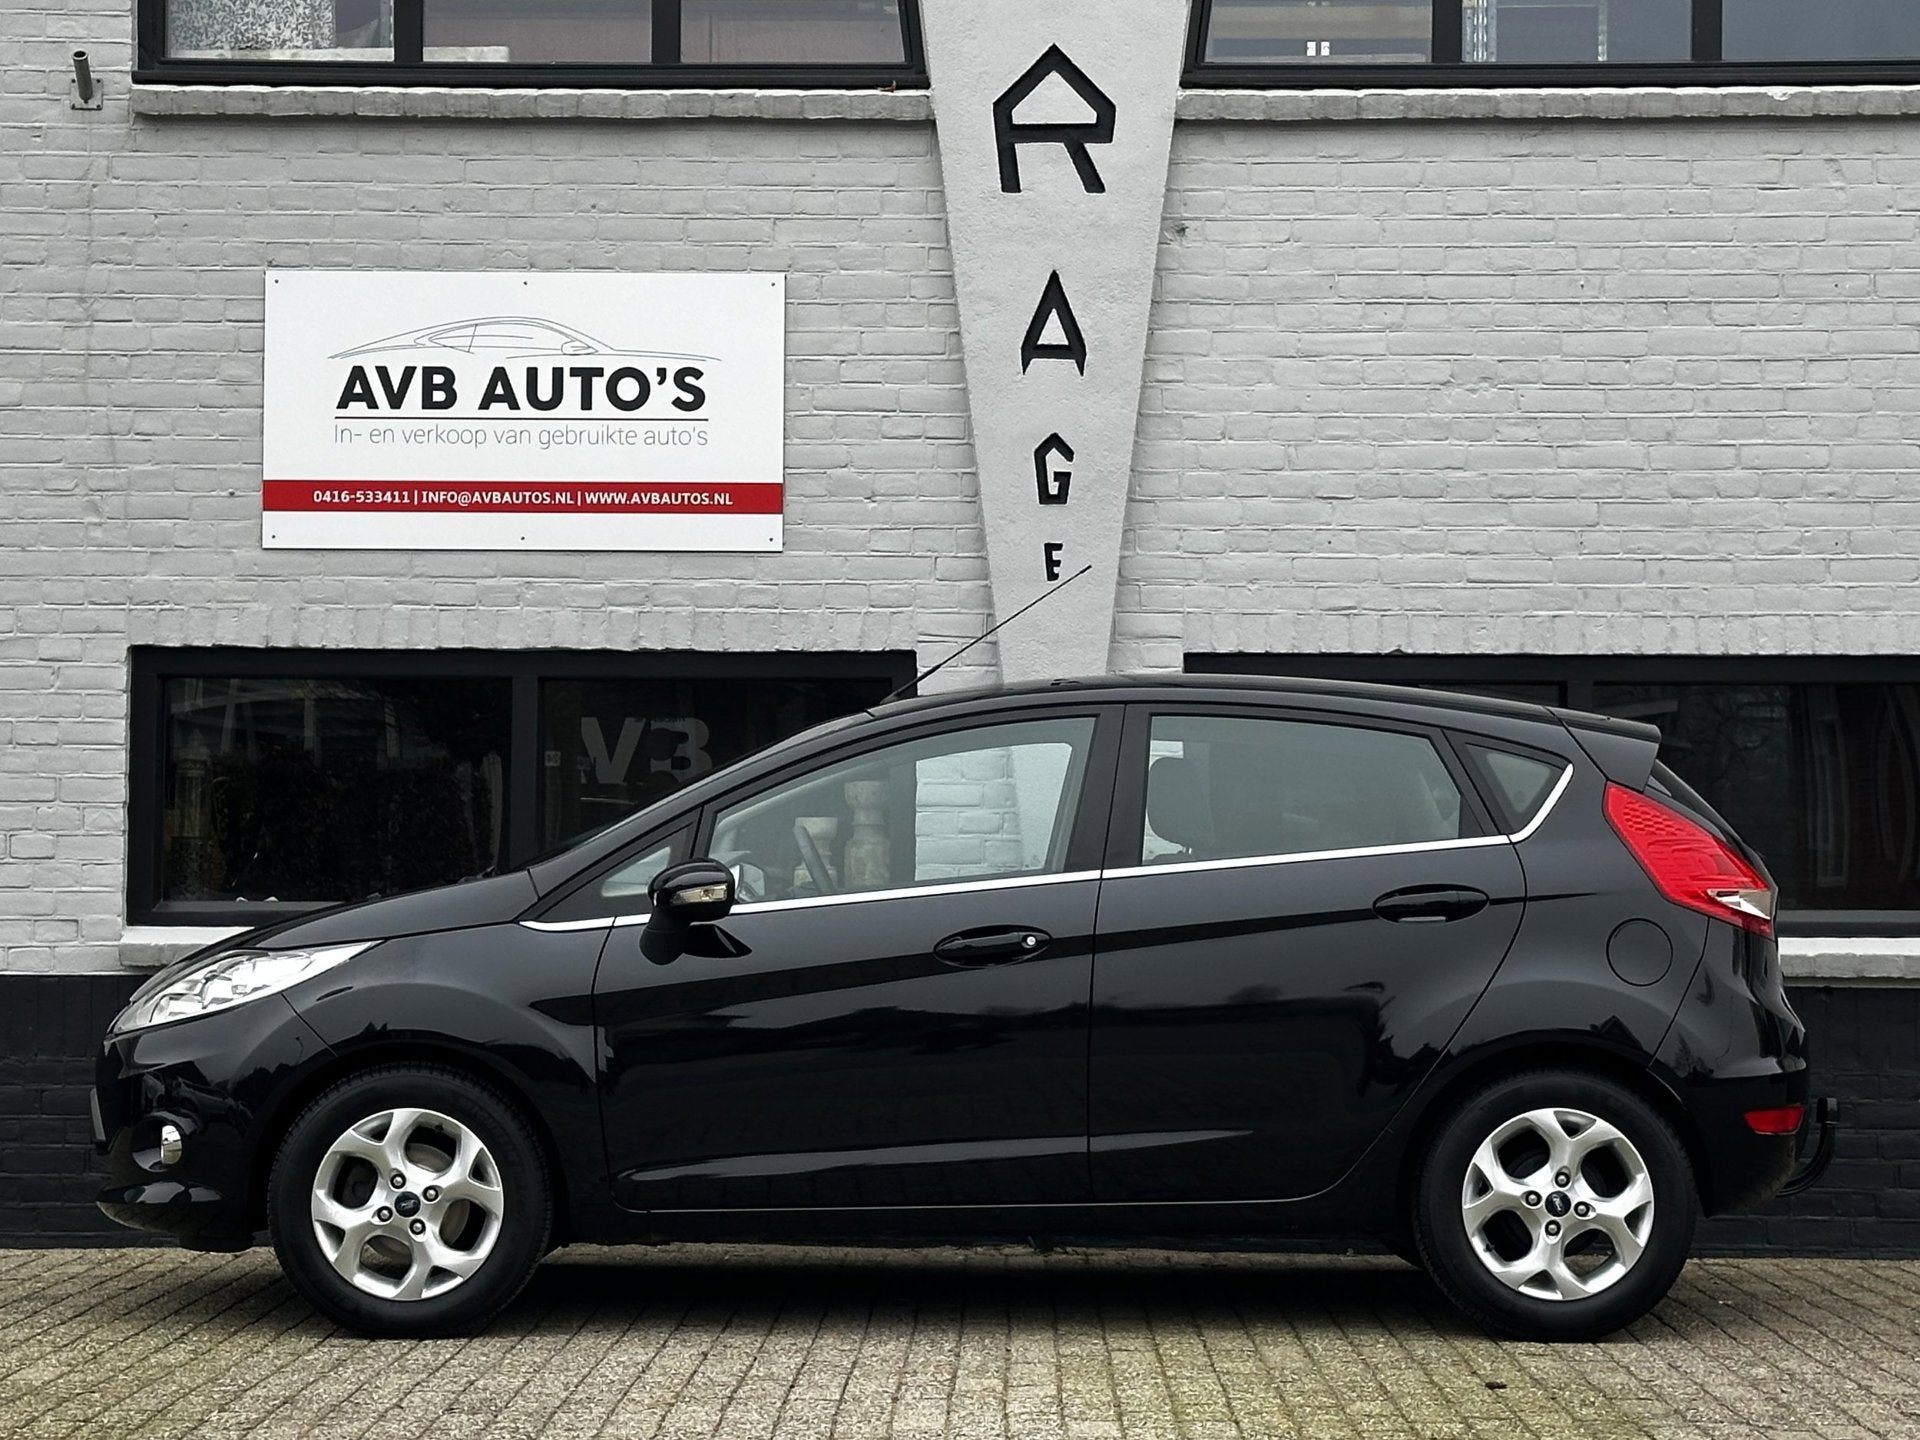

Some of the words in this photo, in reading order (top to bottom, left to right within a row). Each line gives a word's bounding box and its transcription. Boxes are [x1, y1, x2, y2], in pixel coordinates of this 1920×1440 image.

[992, 43, 1117, 582] RAGE
[335, 365, 458, 410] AVB
[477, 366, 706, 412] AUTO'S
[334, 423, 363, 444] In-
[369, 428, 395, 444] en
[402, 424, 487, 450] verkoop
[493, 429, 532, 445] van
[538, 425, 638, 451] gebruikte
[643, 426, 709, 447] auto's
[313, 490, 410, 504] 0416-533411
[421, 490, 575, 507] INFO@AVBAUTOS.NL
[584, 491, 735, 506] WWW.AVBAUTOS.NL
